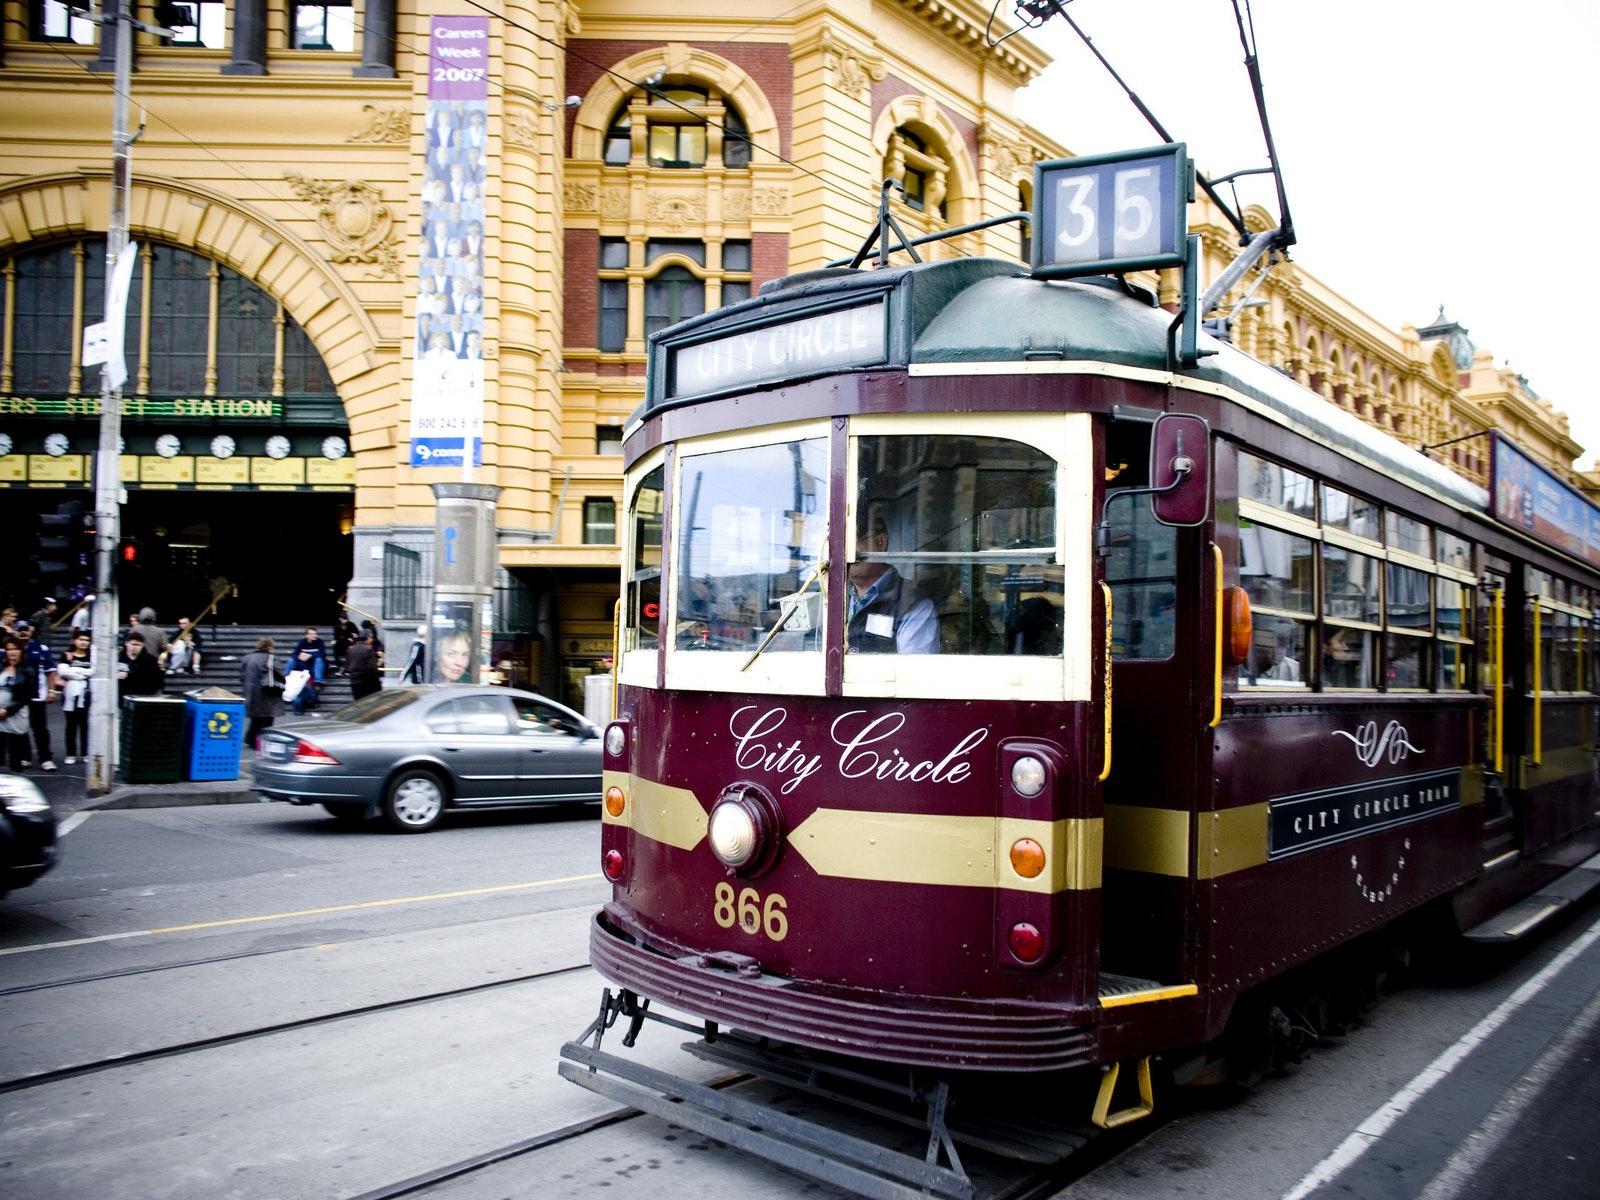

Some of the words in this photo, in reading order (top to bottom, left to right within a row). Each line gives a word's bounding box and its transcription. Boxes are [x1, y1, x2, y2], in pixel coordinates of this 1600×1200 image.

[434, 27, 486, 39] Carers
[437, 47, 482, 58] Week
[433, 68, 486, 81] 2007
[1058, 168, 1153, 247] 35
[698, 336, 758, 379] CITY
[768, 313, 868, 366] CIRCLE
[65, 398, 148, 416] STRET
[173, 399, 273, 417] STATION
[729, 705, 822, 795] City
[830, 710, 989, 784] Circle
[1294, 809, 1341, 834] CITY
[1353, 794, 1411, 819] CIRCLE
[1418, 785, 1450, 805] TRAM
[713, 882, 789, 942] 866
